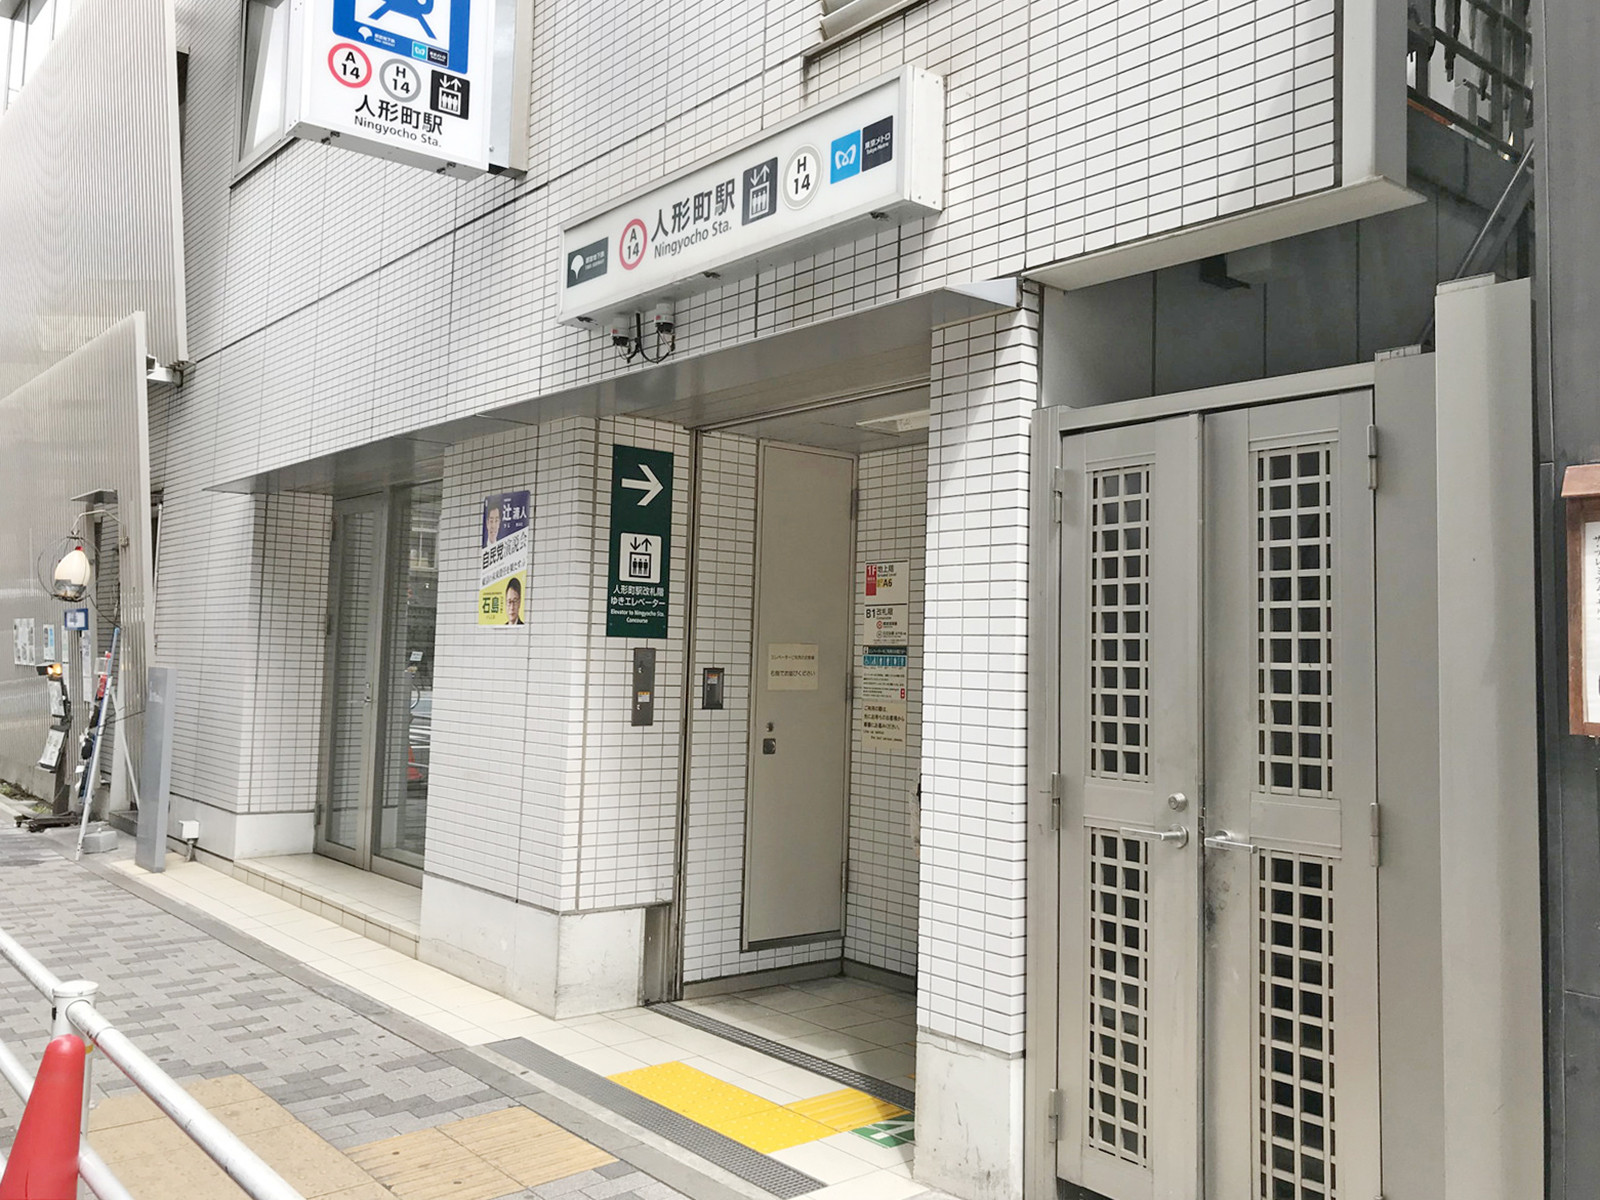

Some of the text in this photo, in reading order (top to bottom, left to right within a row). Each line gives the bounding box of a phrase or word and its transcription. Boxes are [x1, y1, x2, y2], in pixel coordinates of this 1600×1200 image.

[345, 51, 356, 64] A
[342, 63, 360, 79] 14
[396, 66, 406, 78] H
[393, 78, 410, 94] 14
[355, 94, 443, 135] 人形町駅
[354, 115, 442, 147] Ningyocho Sta.
[797, 156, 807, 174] H
[793, 173, 811, 195] 14
[651, 178, 735, 242] 人形町駅
[629, 228, 638, 243] A
[654, 220, 732, 259] Ningyocho Sta.
[627, 242, 640, 260] 14
[613, 584, 664, 597] 人形町駅改札階
[610, 596, 666, 608] ゆきエレベーター
[866, 608, 876, 618] B1
